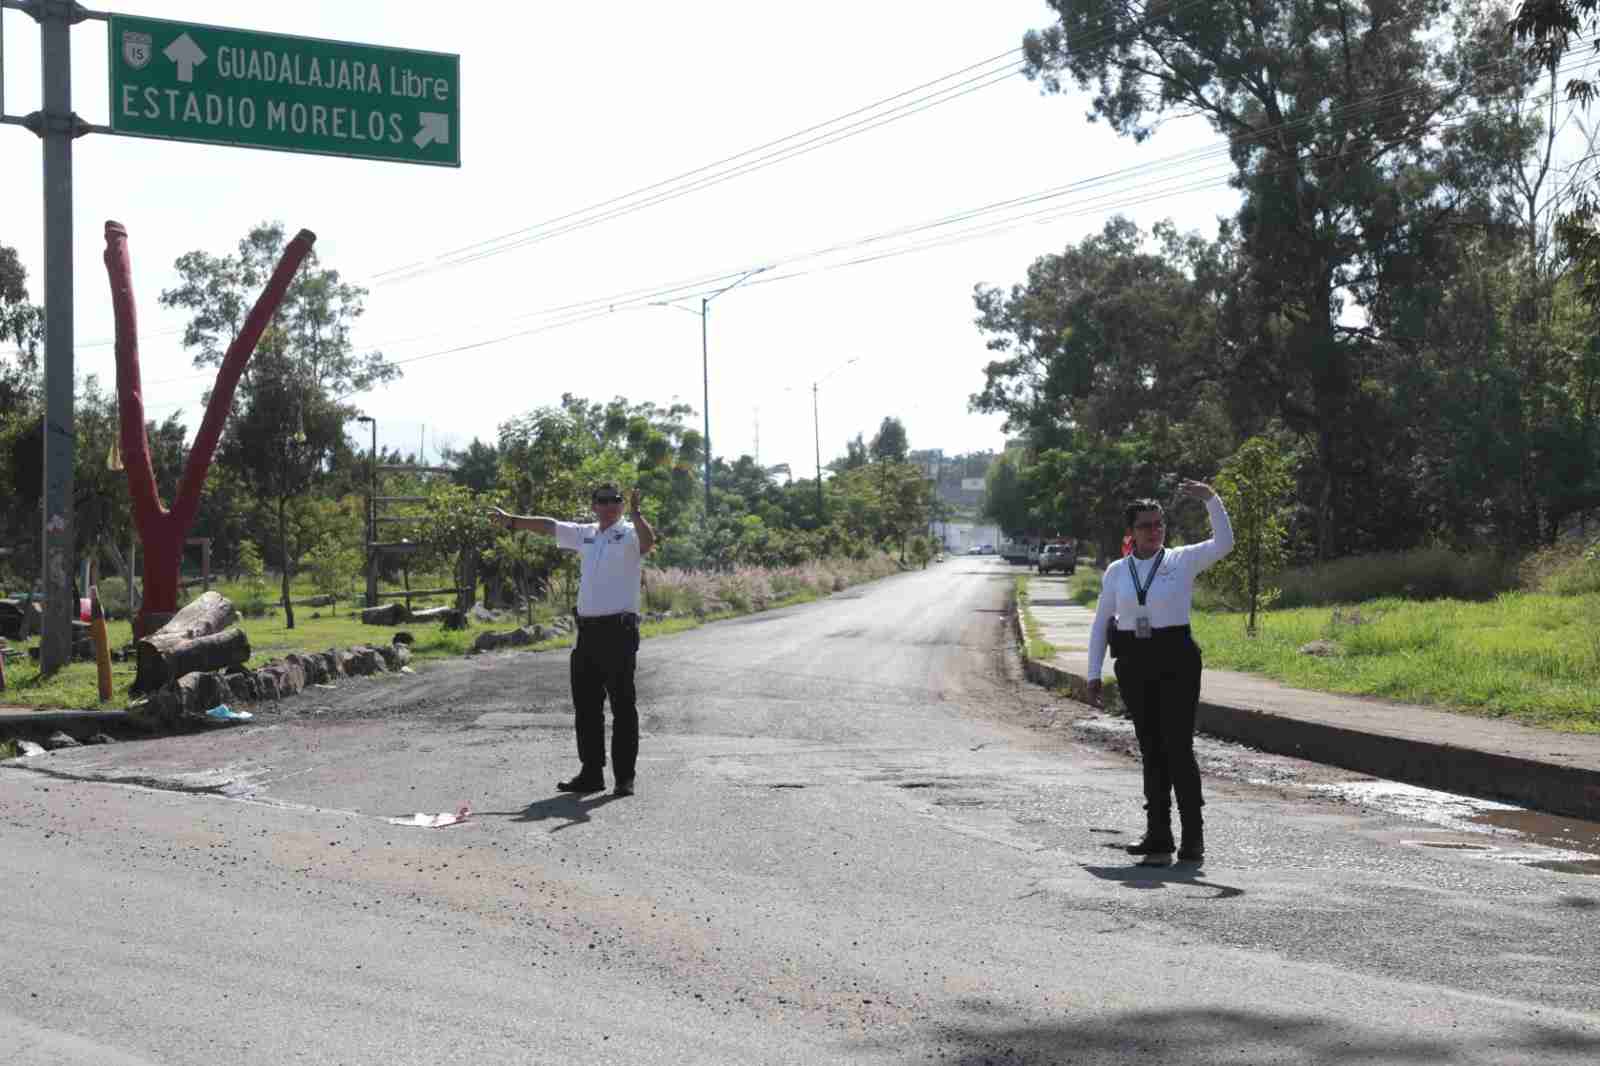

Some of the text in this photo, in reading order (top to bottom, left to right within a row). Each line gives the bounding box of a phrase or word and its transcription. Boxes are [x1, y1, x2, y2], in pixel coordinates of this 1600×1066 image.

[130, 48, 145, 60] 15
[217, 45, 449, 100] GUADALAJARA Libre
[122, 85, 404, 144] ESTADIO MORELOS
